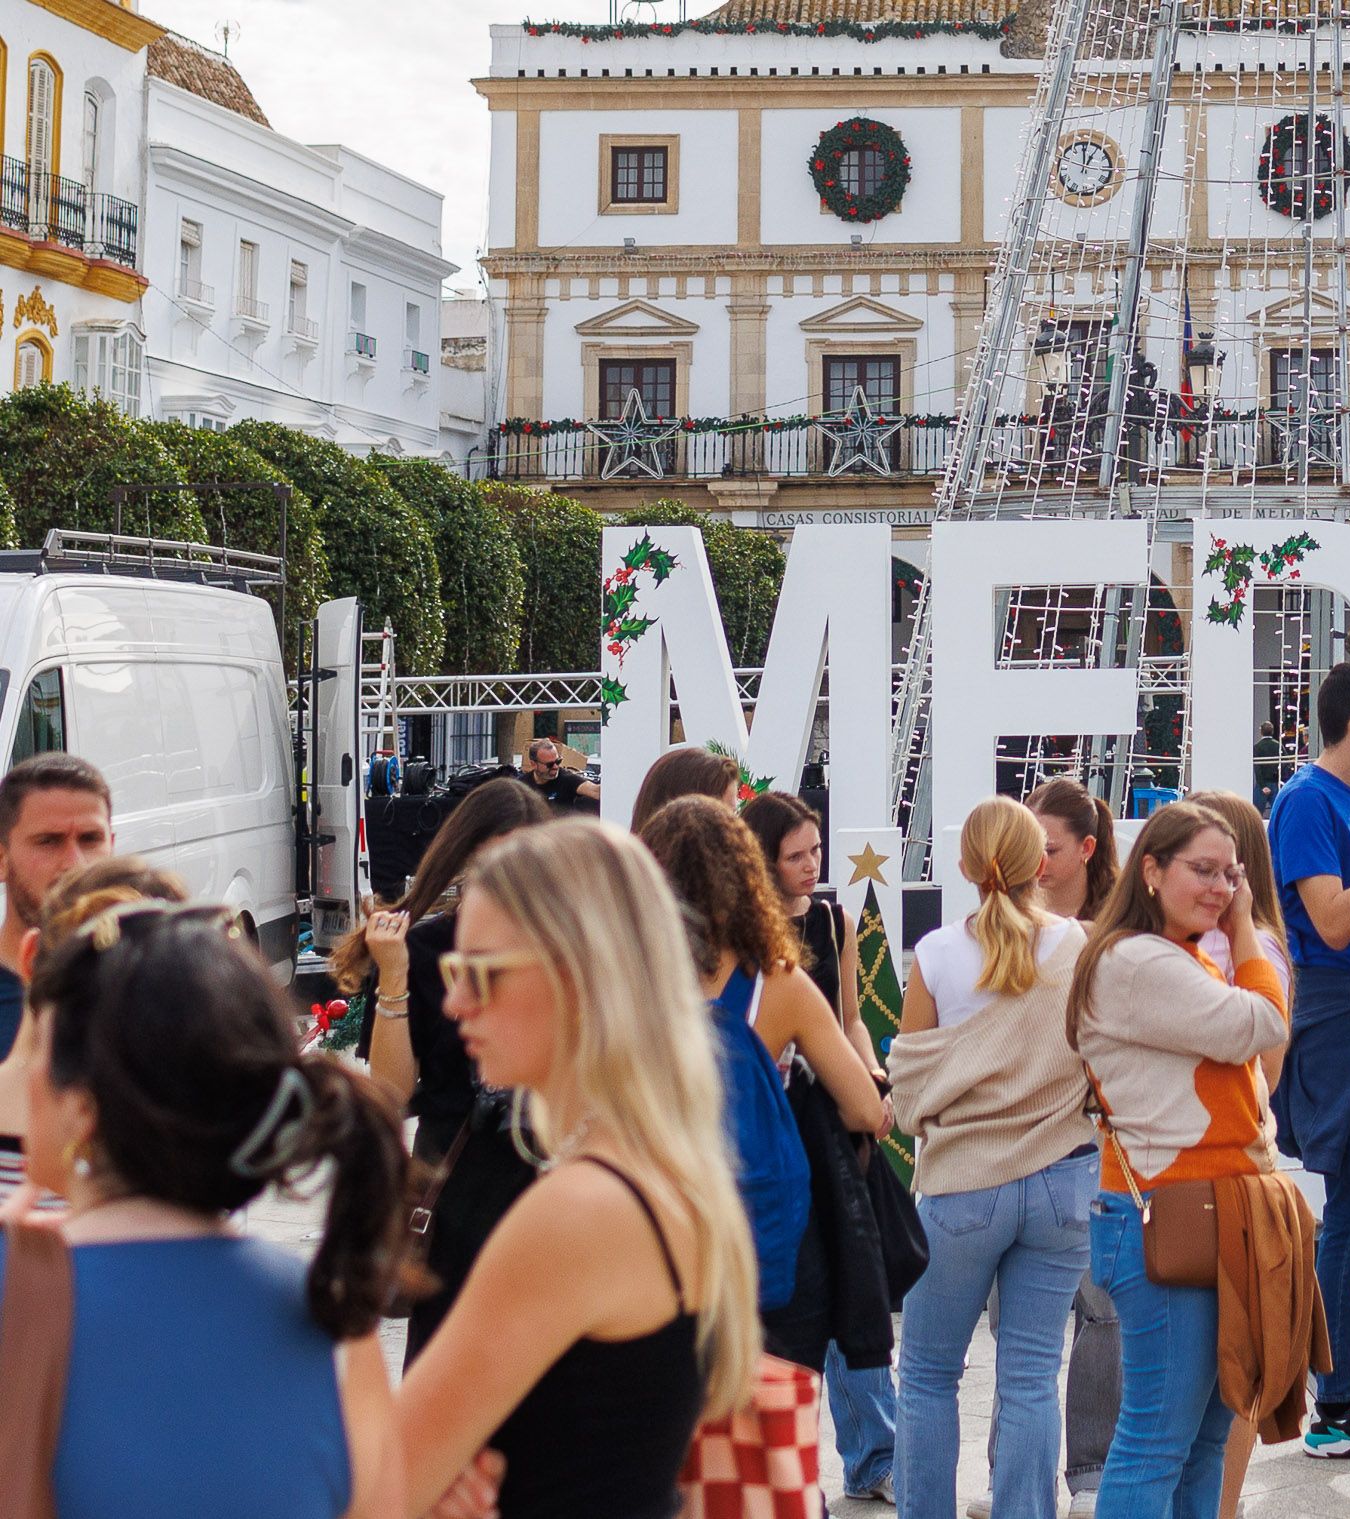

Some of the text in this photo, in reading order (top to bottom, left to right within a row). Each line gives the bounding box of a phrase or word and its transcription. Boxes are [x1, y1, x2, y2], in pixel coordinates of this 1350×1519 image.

[766, 513, 814, 526] CASAS
[822, 511, 938, 524] CONSISTORIAL
[1223, 508, 1243, 519] DE
